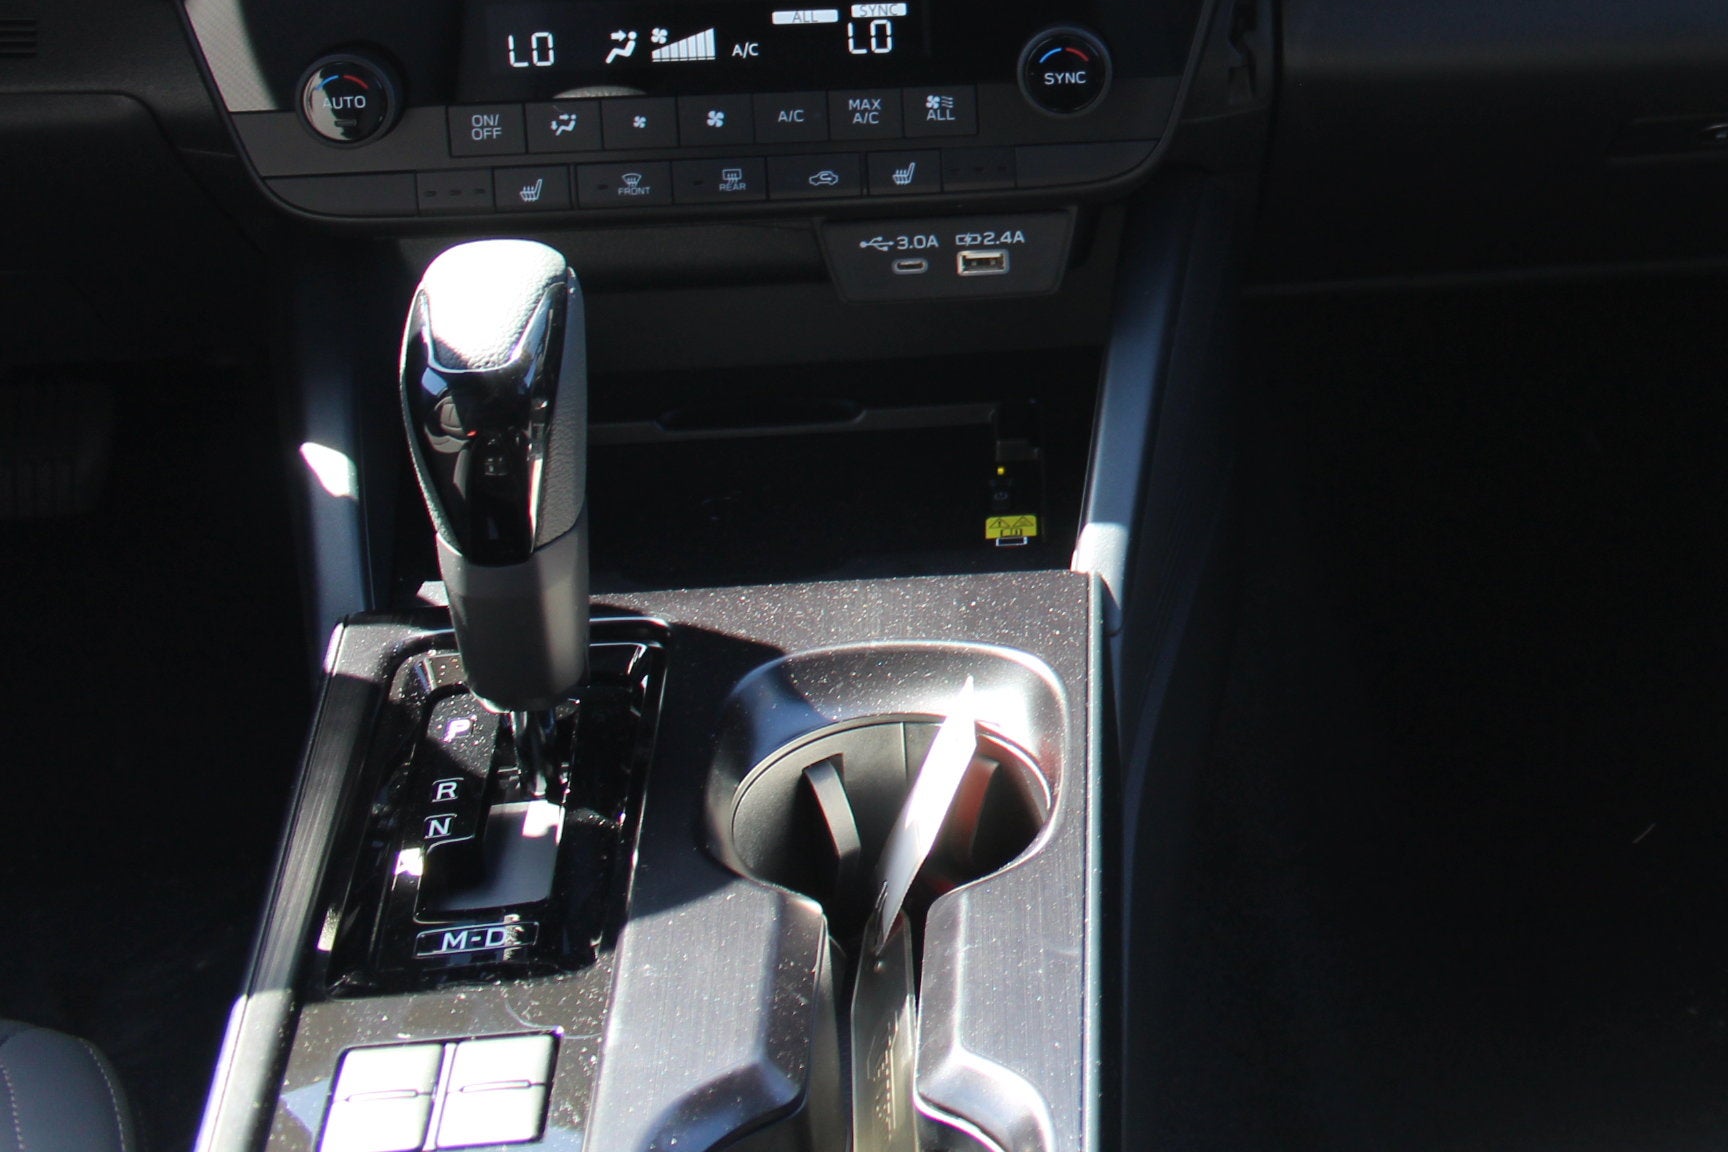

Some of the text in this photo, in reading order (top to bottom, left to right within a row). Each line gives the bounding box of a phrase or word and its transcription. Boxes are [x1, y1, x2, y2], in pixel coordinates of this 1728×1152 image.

[792, 11, 819, 23] ALL
[859, 4, 900, 17] SYNC
[848, 19, 893, 54] LO
[508, 32, 555, 67] LO
[732, 42, 759, 59] A/C
[1044, 71, 1087, 85] SYNC
[323, 95, 366, 109] AUTO
[848, 98, 882, 111] MAX
[471, 114, 500, 127] ON/
[777, 109, 804, 123] A/C
[852, 111, 880, 124] A/C
[926, 109, 955, 121] ALL
[471, 127, 502, 141] OFF
[618, 186, 650, 196] FRONT
[719, 183, 746, 192] REAR
[896, 230, 1025, 250] 3.0A 2.4A
[444, 719, 472, 742] P
[436, 782, 457, 800] R
[428, 818, 450, 837] N
[441, 928, 509, 952] M-D
